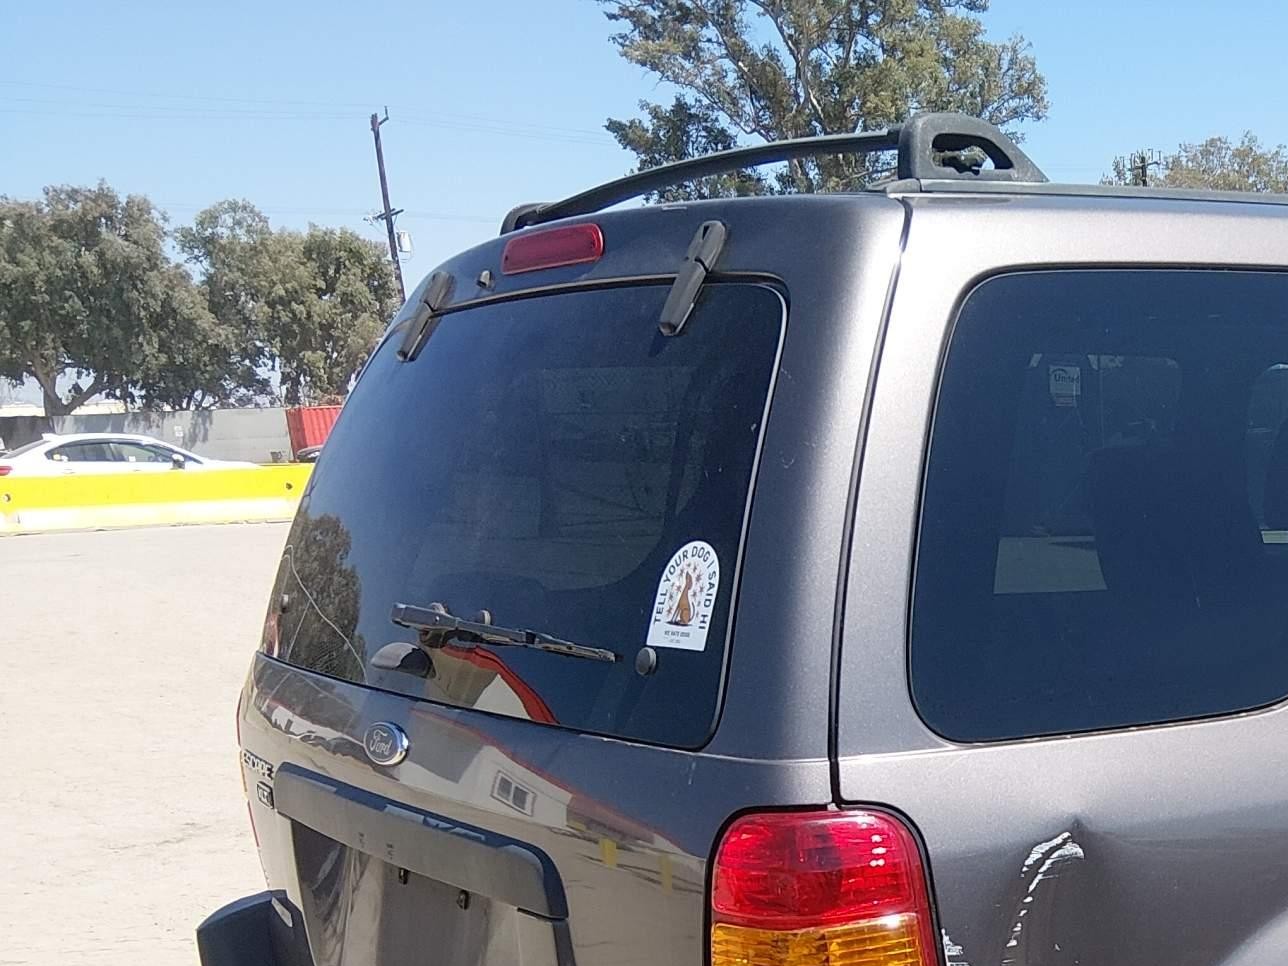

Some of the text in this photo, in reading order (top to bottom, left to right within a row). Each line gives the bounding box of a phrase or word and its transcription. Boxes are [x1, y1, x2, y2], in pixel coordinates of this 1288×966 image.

[663, 549, 689, 583] YOUR
[691, 546, 711, 562] DOG
[704, 571, 717, 607] SAID
[655, 590, 668, 623] TELL
[698, 614, 708, 630] HI
